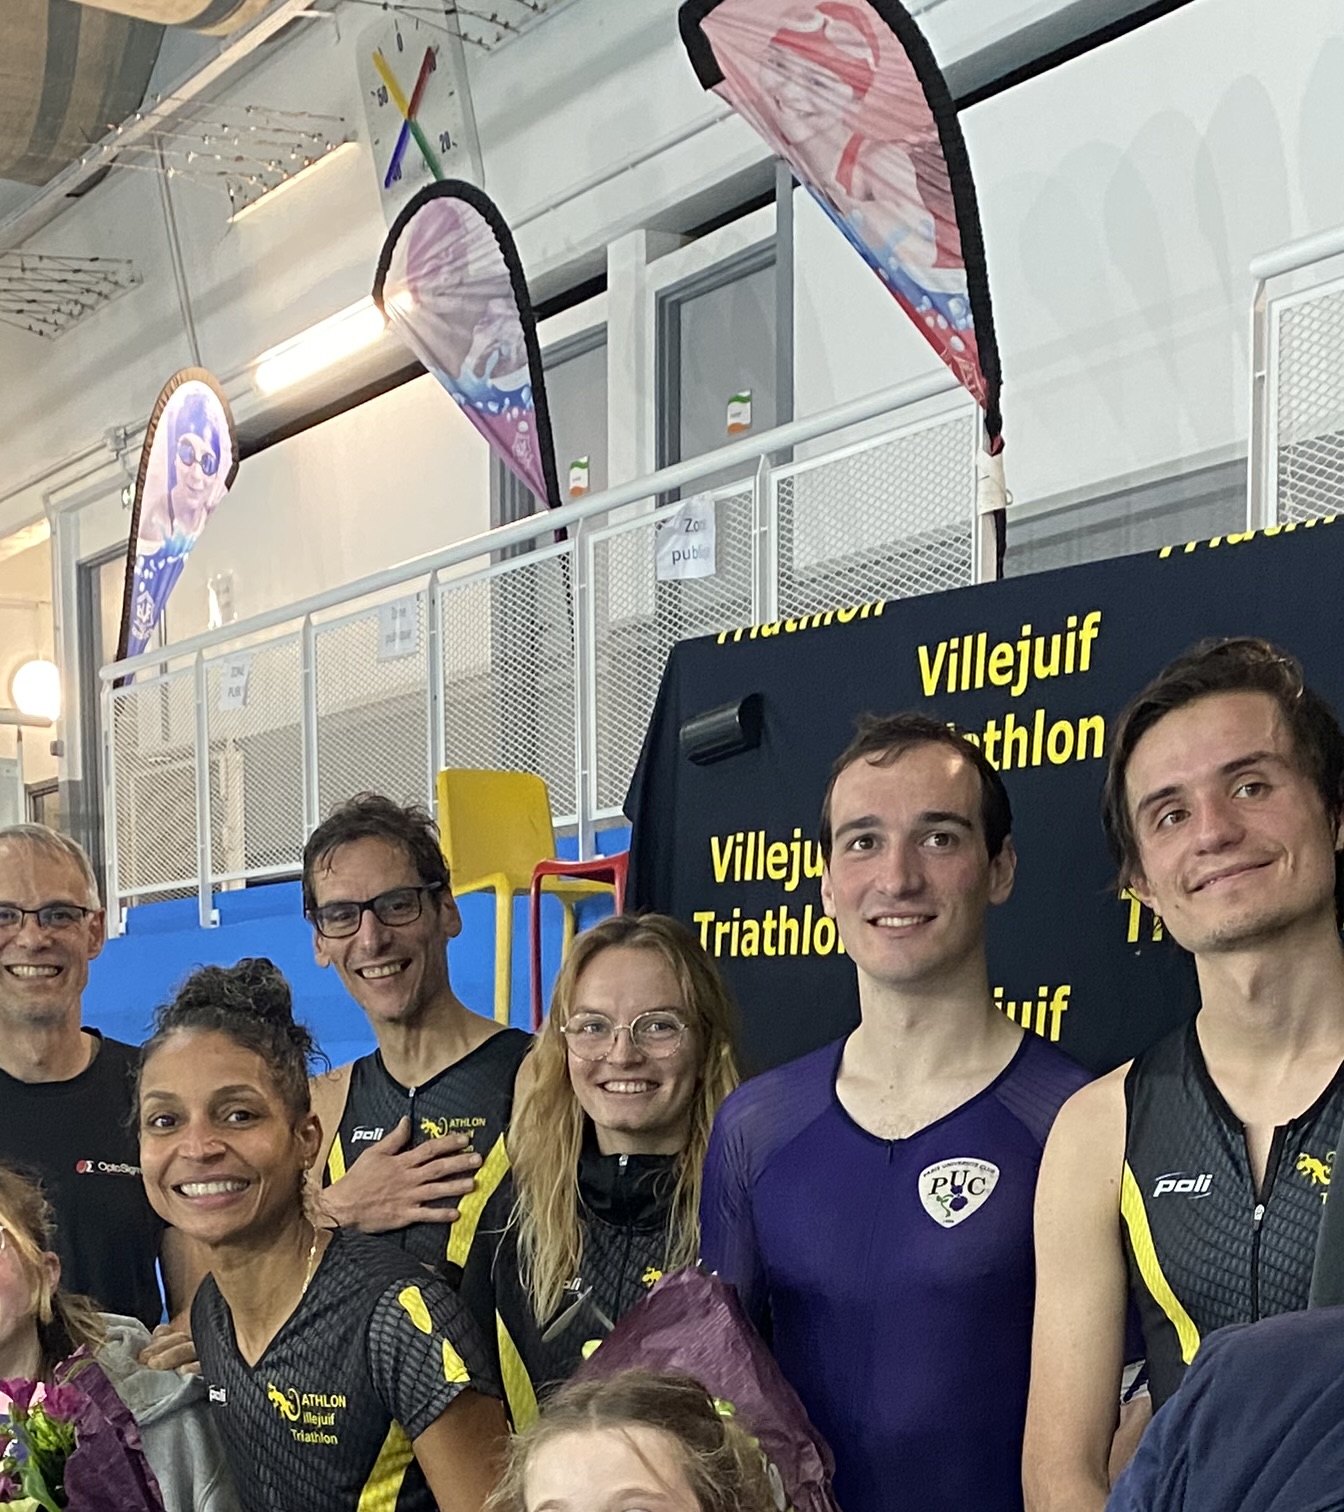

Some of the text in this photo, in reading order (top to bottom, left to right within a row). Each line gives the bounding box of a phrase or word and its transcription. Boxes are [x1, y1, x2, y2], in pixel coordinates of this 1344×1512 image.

[439, 130, 452, 153] 20
[917, 610, 1102, 697] Villejuif
[947, 708, 1106, 771] thlon
[710, 827, 826, 892] Villeju
[693, 904, 847, 958] Triathlo
[928, 1169, 987, 1196] PUC
[1153, 1173, 1214, 1198] poli
[563, 1277, 582, 1291] oli
[301, 1393, 346, 1408] ATHLON
[290, 1428, 339, 1445] Triathlon
